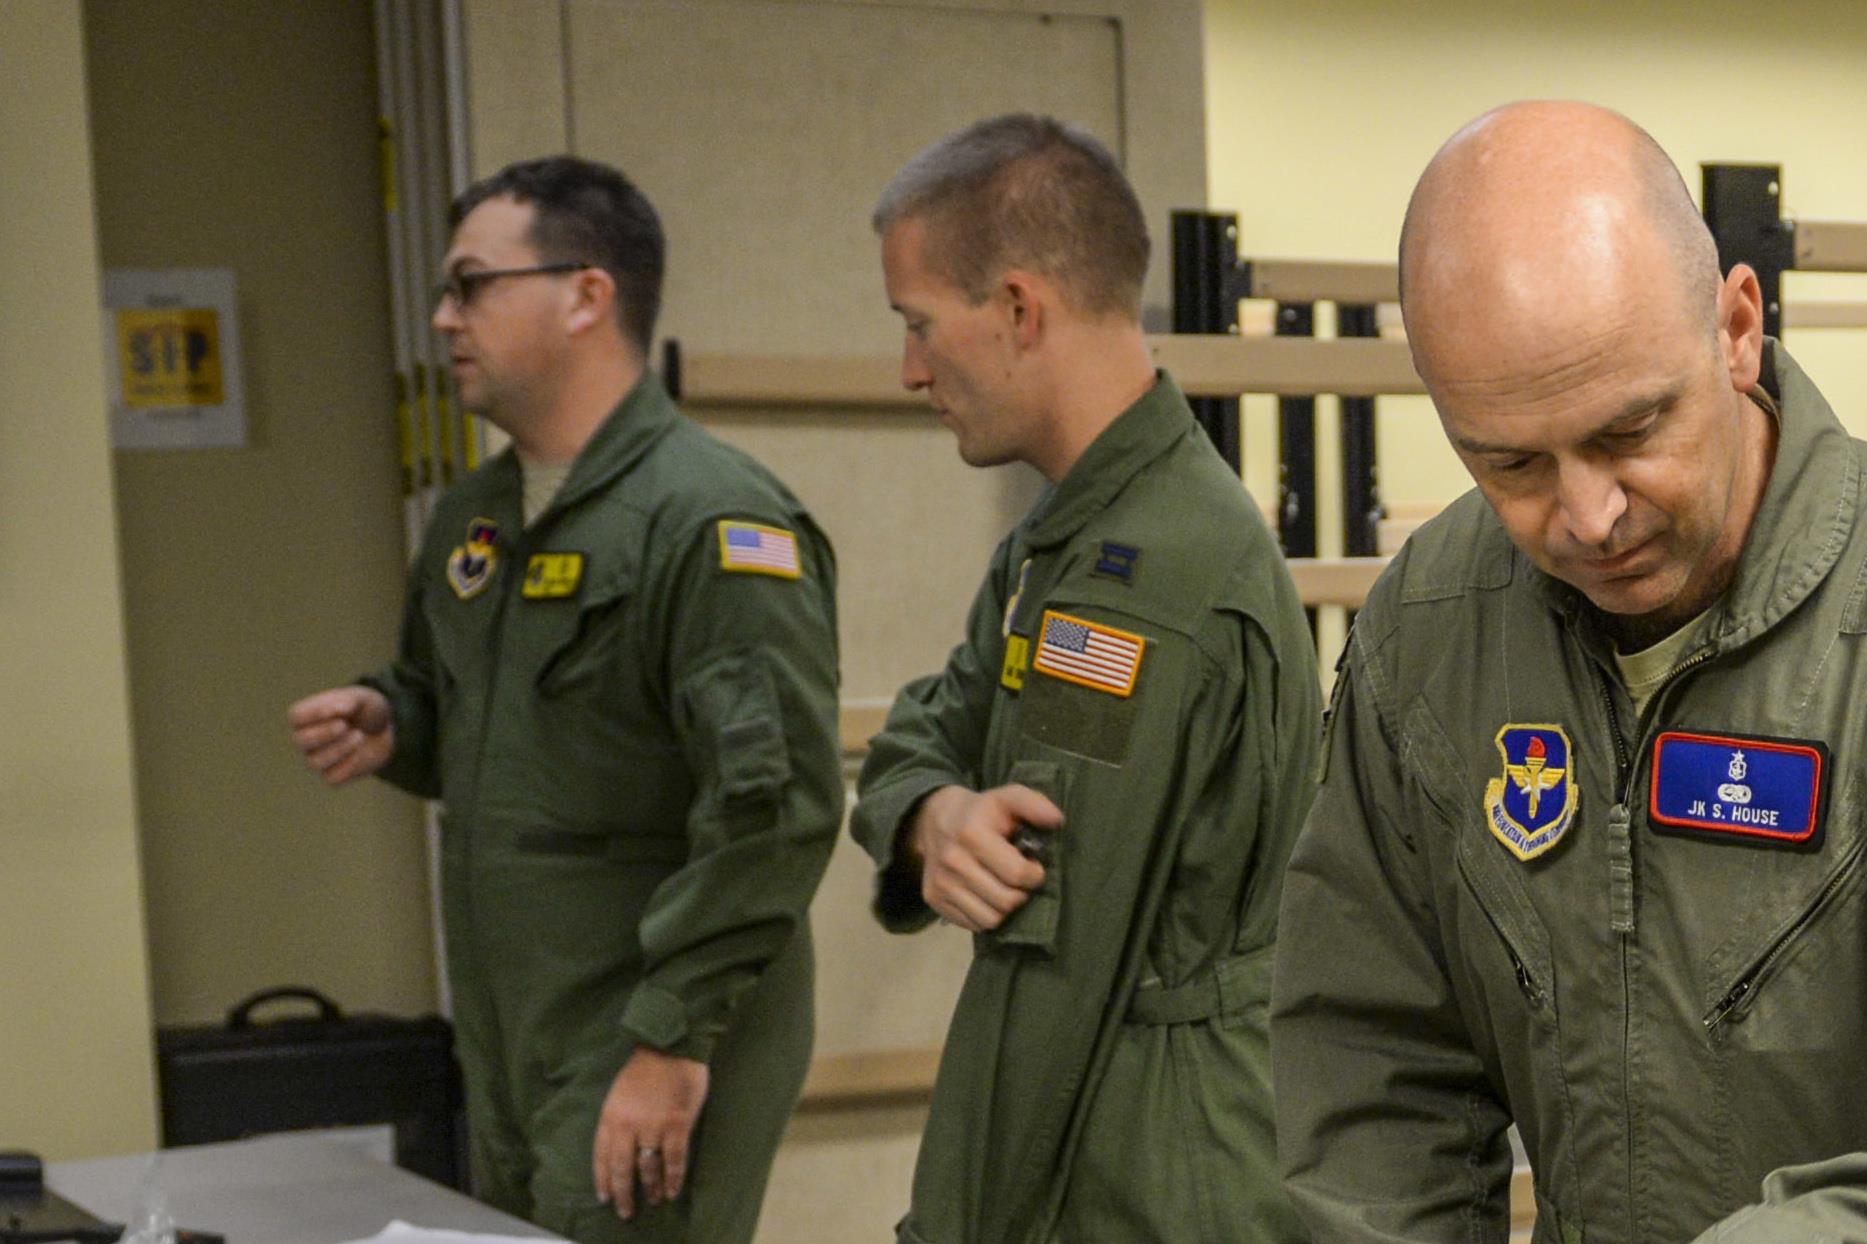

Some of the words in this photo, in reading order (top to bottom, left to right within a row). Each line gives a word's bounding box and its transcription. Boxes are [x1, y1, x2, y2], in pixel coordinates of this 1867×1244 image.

[1688, 800, 1706, 816] JK
[1712, 803, 1726, 820] S.
[1731, 805, 1780, 826] HOUSE
